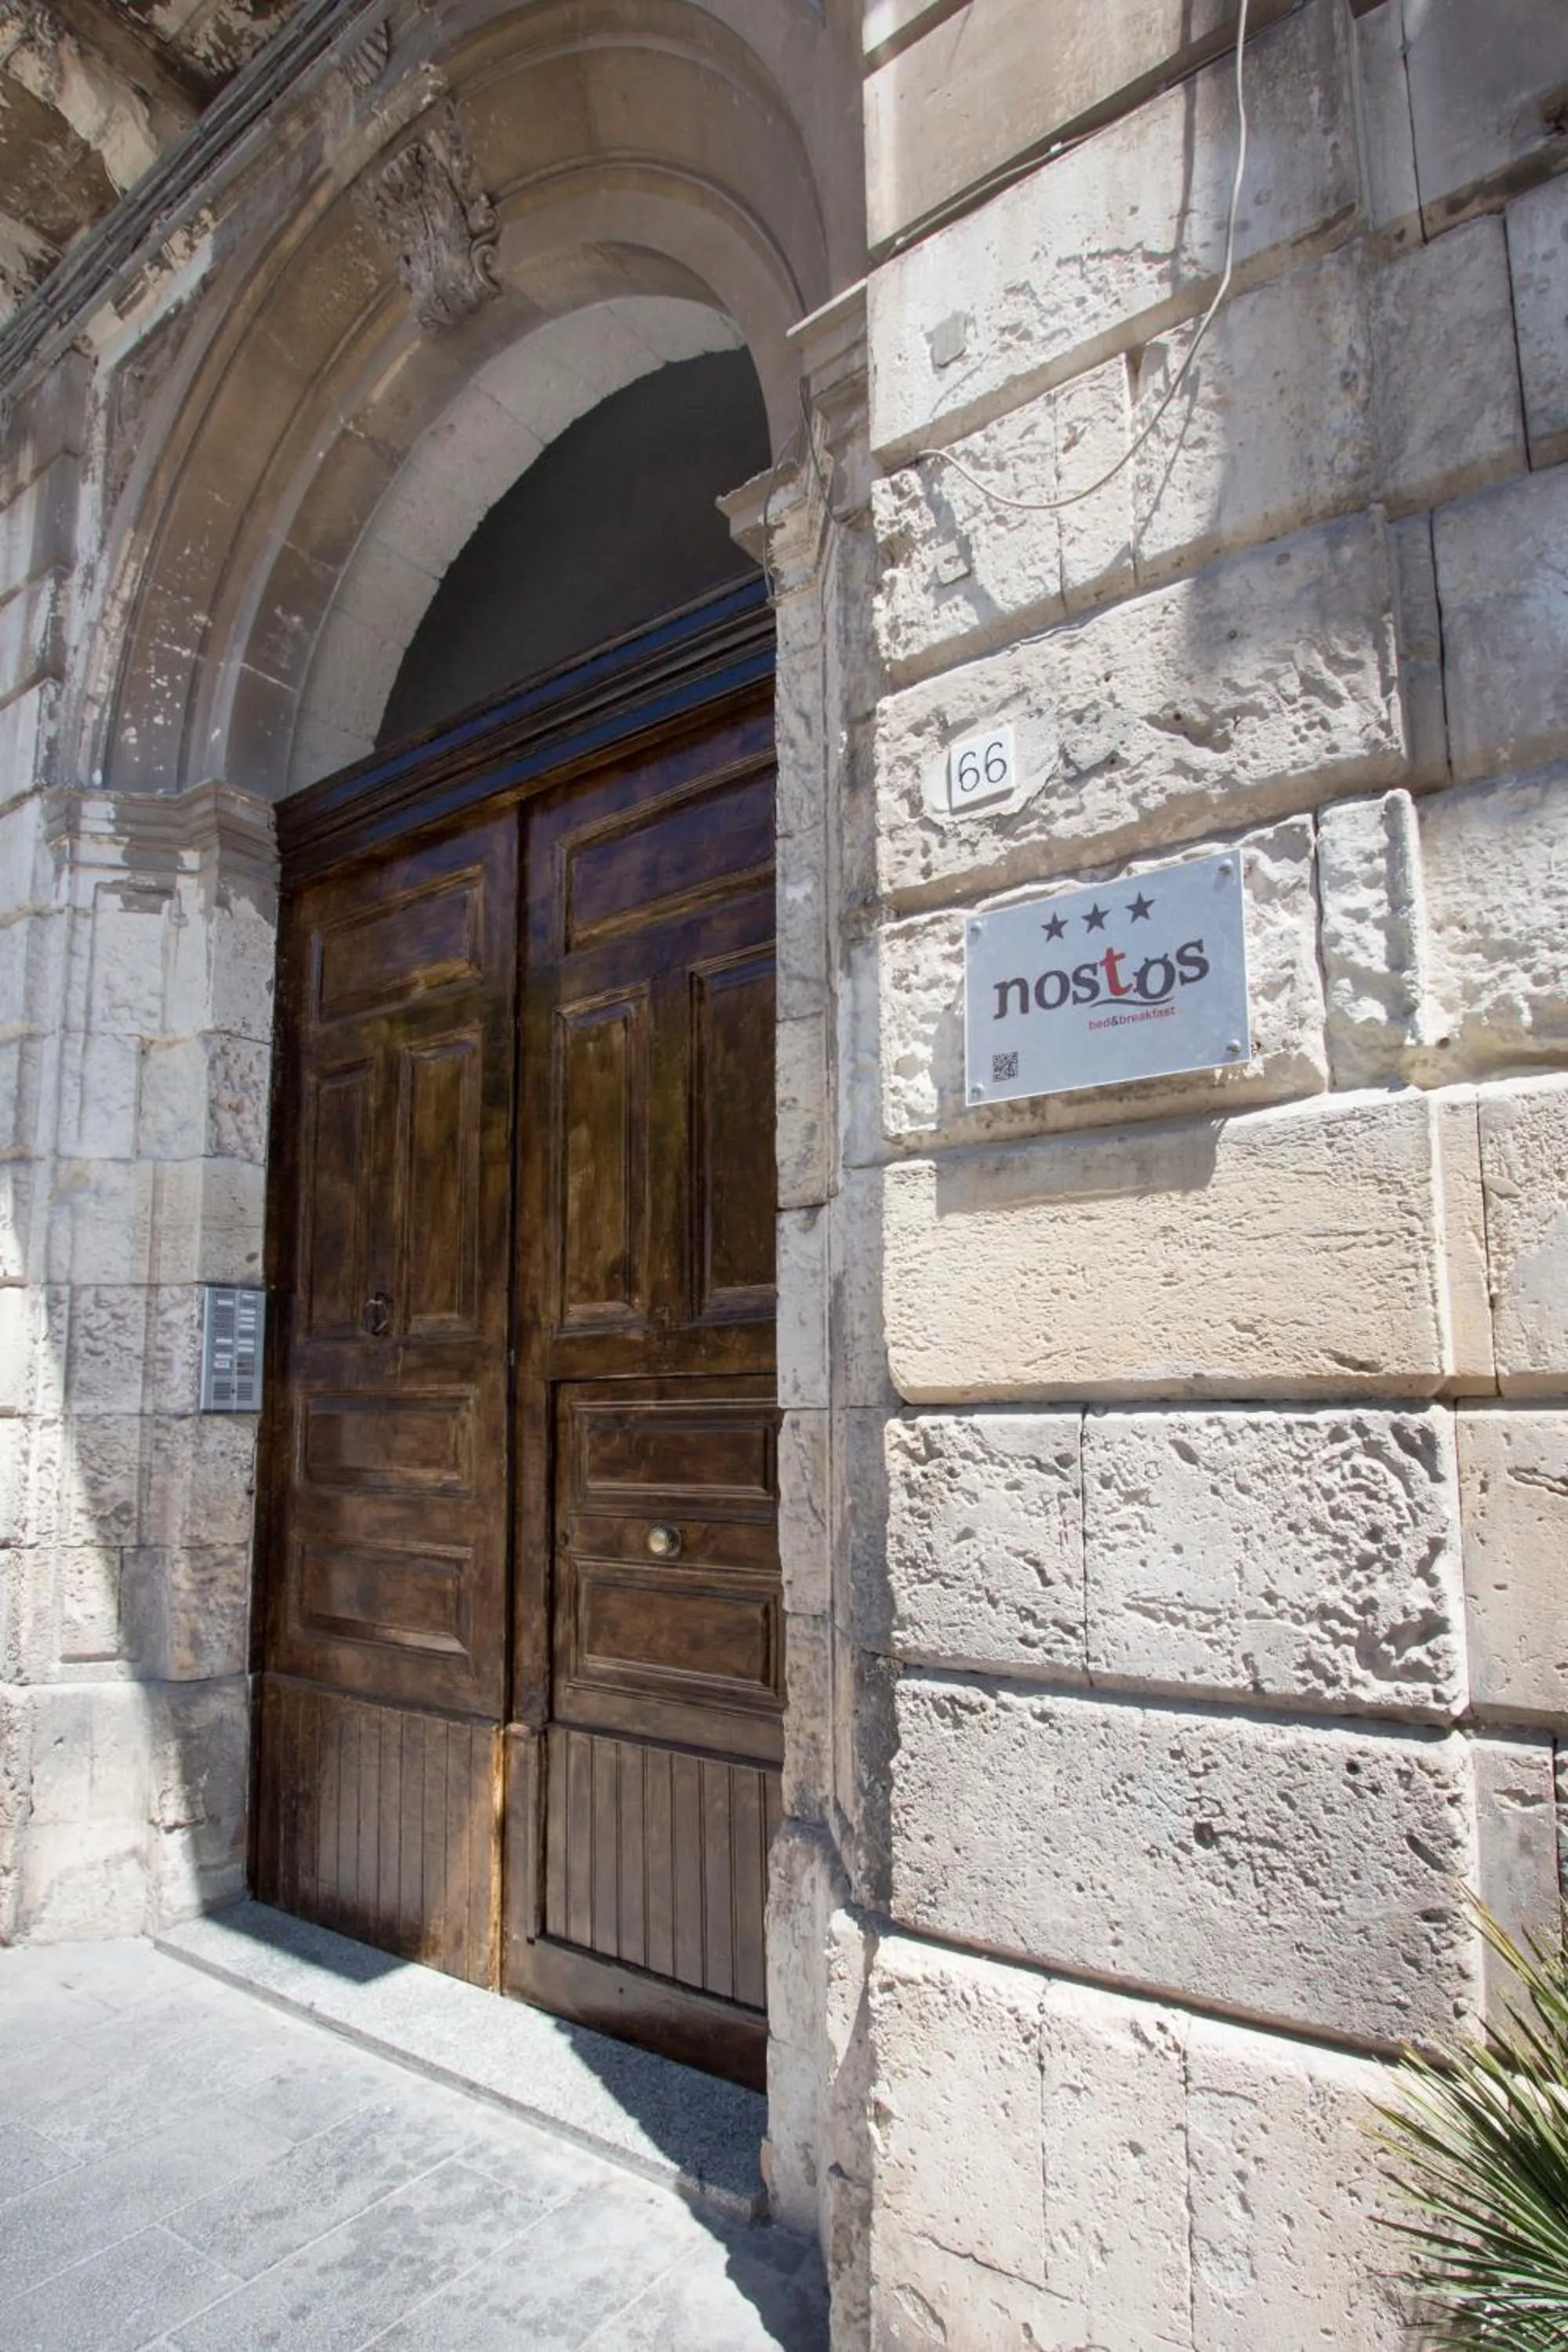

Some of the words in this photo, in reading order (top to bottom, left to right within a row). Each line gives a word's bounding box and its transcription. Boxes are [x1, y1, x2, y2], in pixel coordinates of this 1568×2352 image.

[959, 742, 1007, 793] 66
[993, 938, 1210, 1020] nostos
[1088, 1006, 1177, 1030] bed&breakfast
